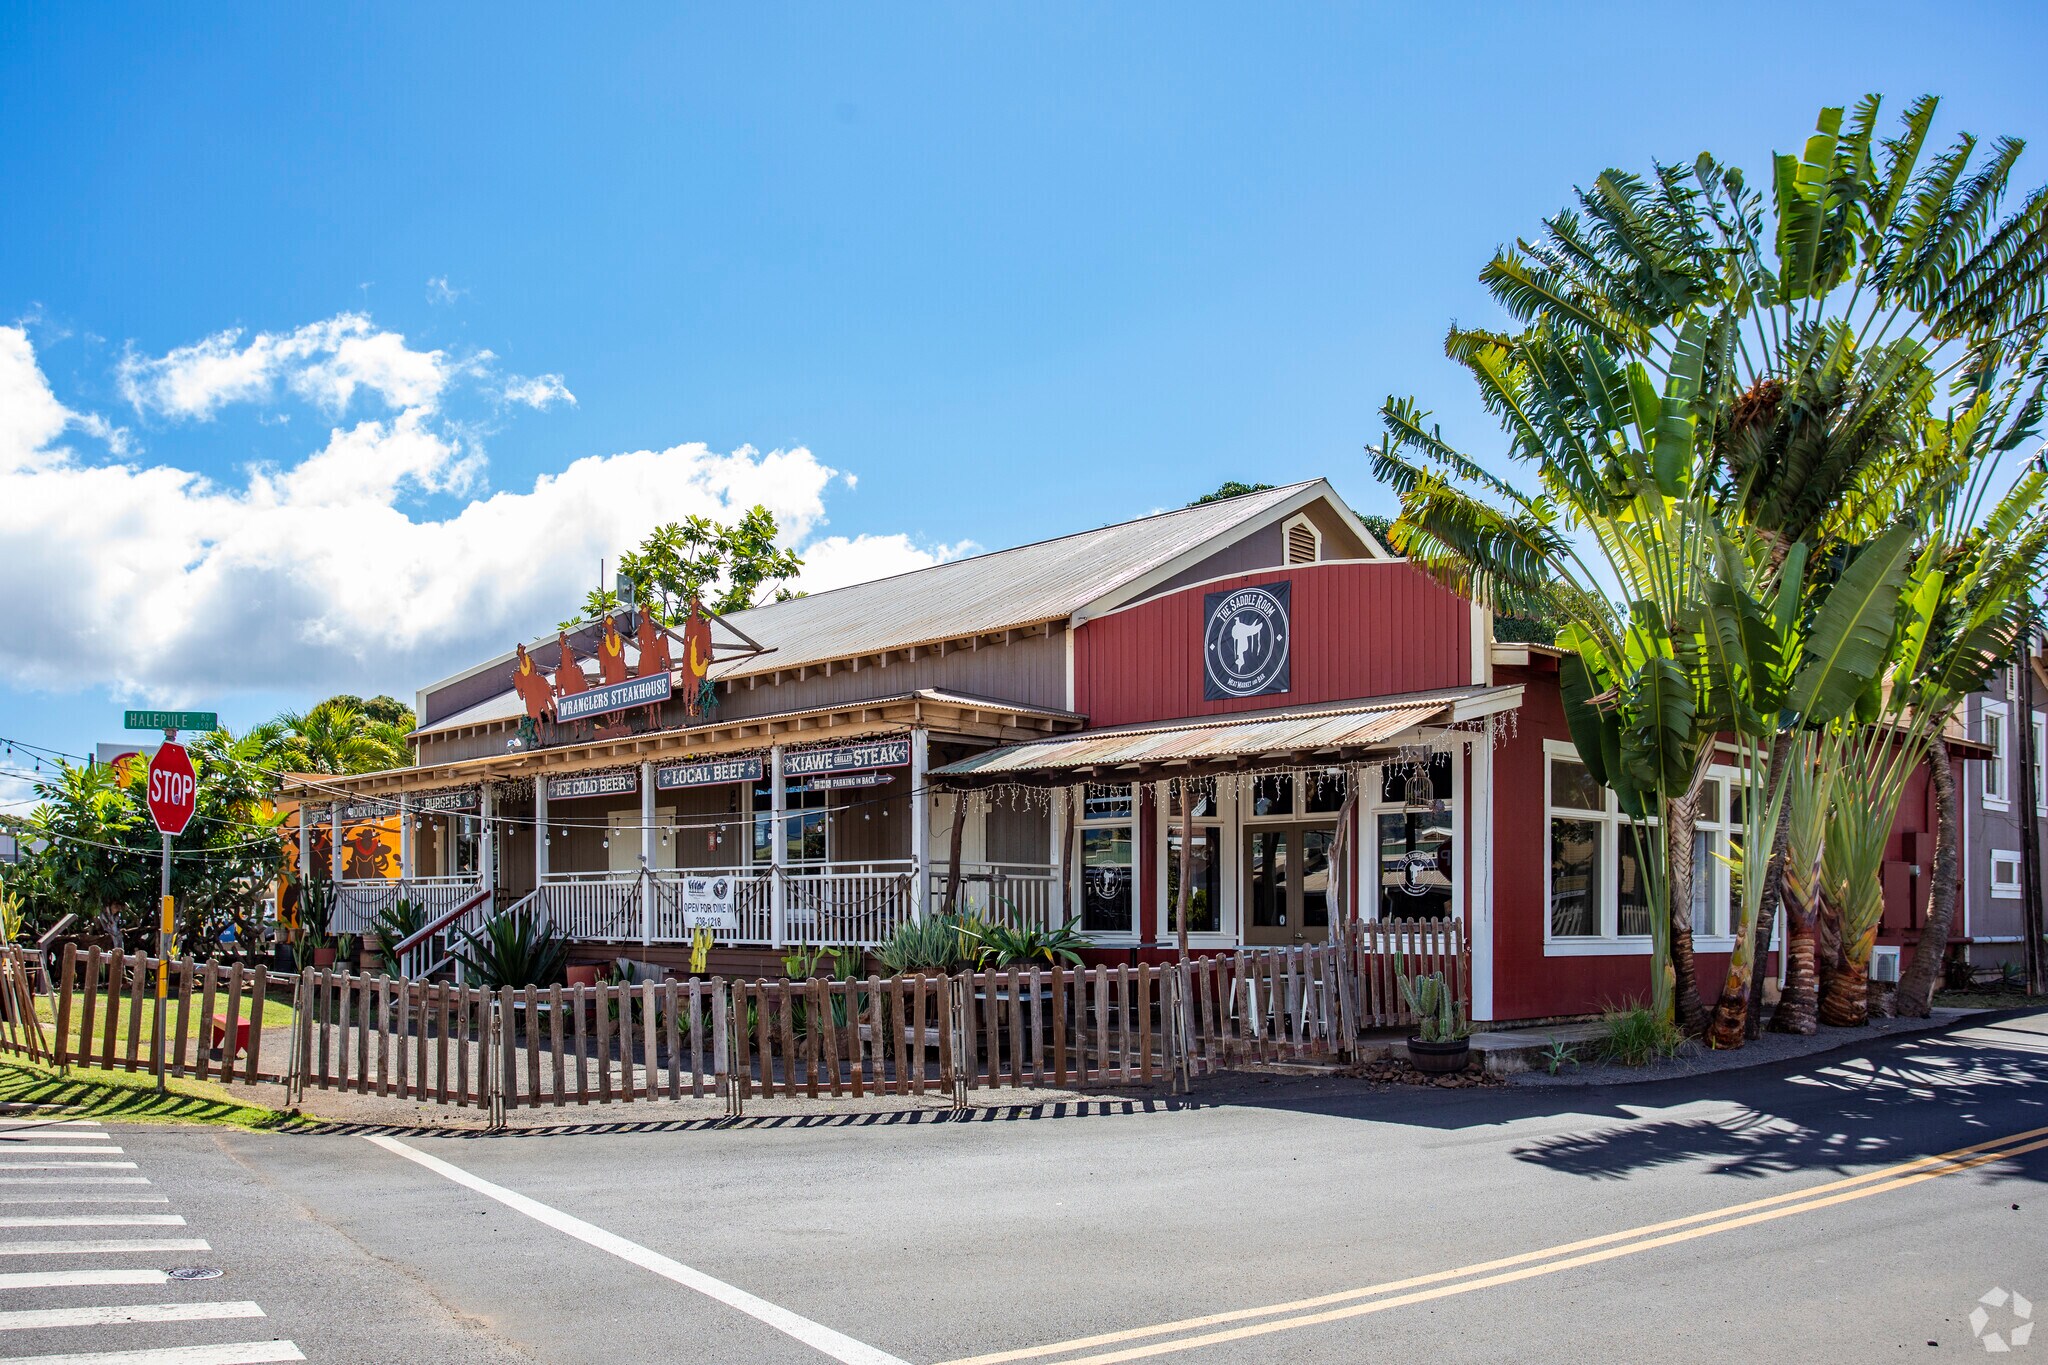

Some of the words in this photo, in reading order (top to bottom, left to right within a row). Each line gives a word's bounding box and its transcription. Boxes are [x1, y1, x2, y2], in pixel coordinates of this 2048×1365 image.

[1217, 606, 1231, 622] THE
[1229, 594, 1257, 611] SADDLE
[1255, 595, 1276, 617] ROOM
[560, 692, 609, 717] WRANGLERS
[611, 678, 667, 706] STEAKHOUSE
[130, 713, 188, 728] HALEPULE
[792, 752, 833, 773] KIAWE
[853, 745, 900, 768] STEAK
[672, 767, 711, 785] LOCAL
[712, 762, 745, 780] BEEF
[832, 778, 856, 788] PARKING
[861, 776, 875, 785] BACK
[151, 768, 193, 807] STOP
[556, 782, 571, 796] ICE
[572, 780, 598, 795] COLD
[599, 776, 626, 792] BEER
[424, 794, 461, 809] BURGERS
[684, 903, 700, 913] OPEN
[700, 903, 712, 913] FOR
[712, 903, 727, 913] DINE
[727, 903, 734, 913] IN
